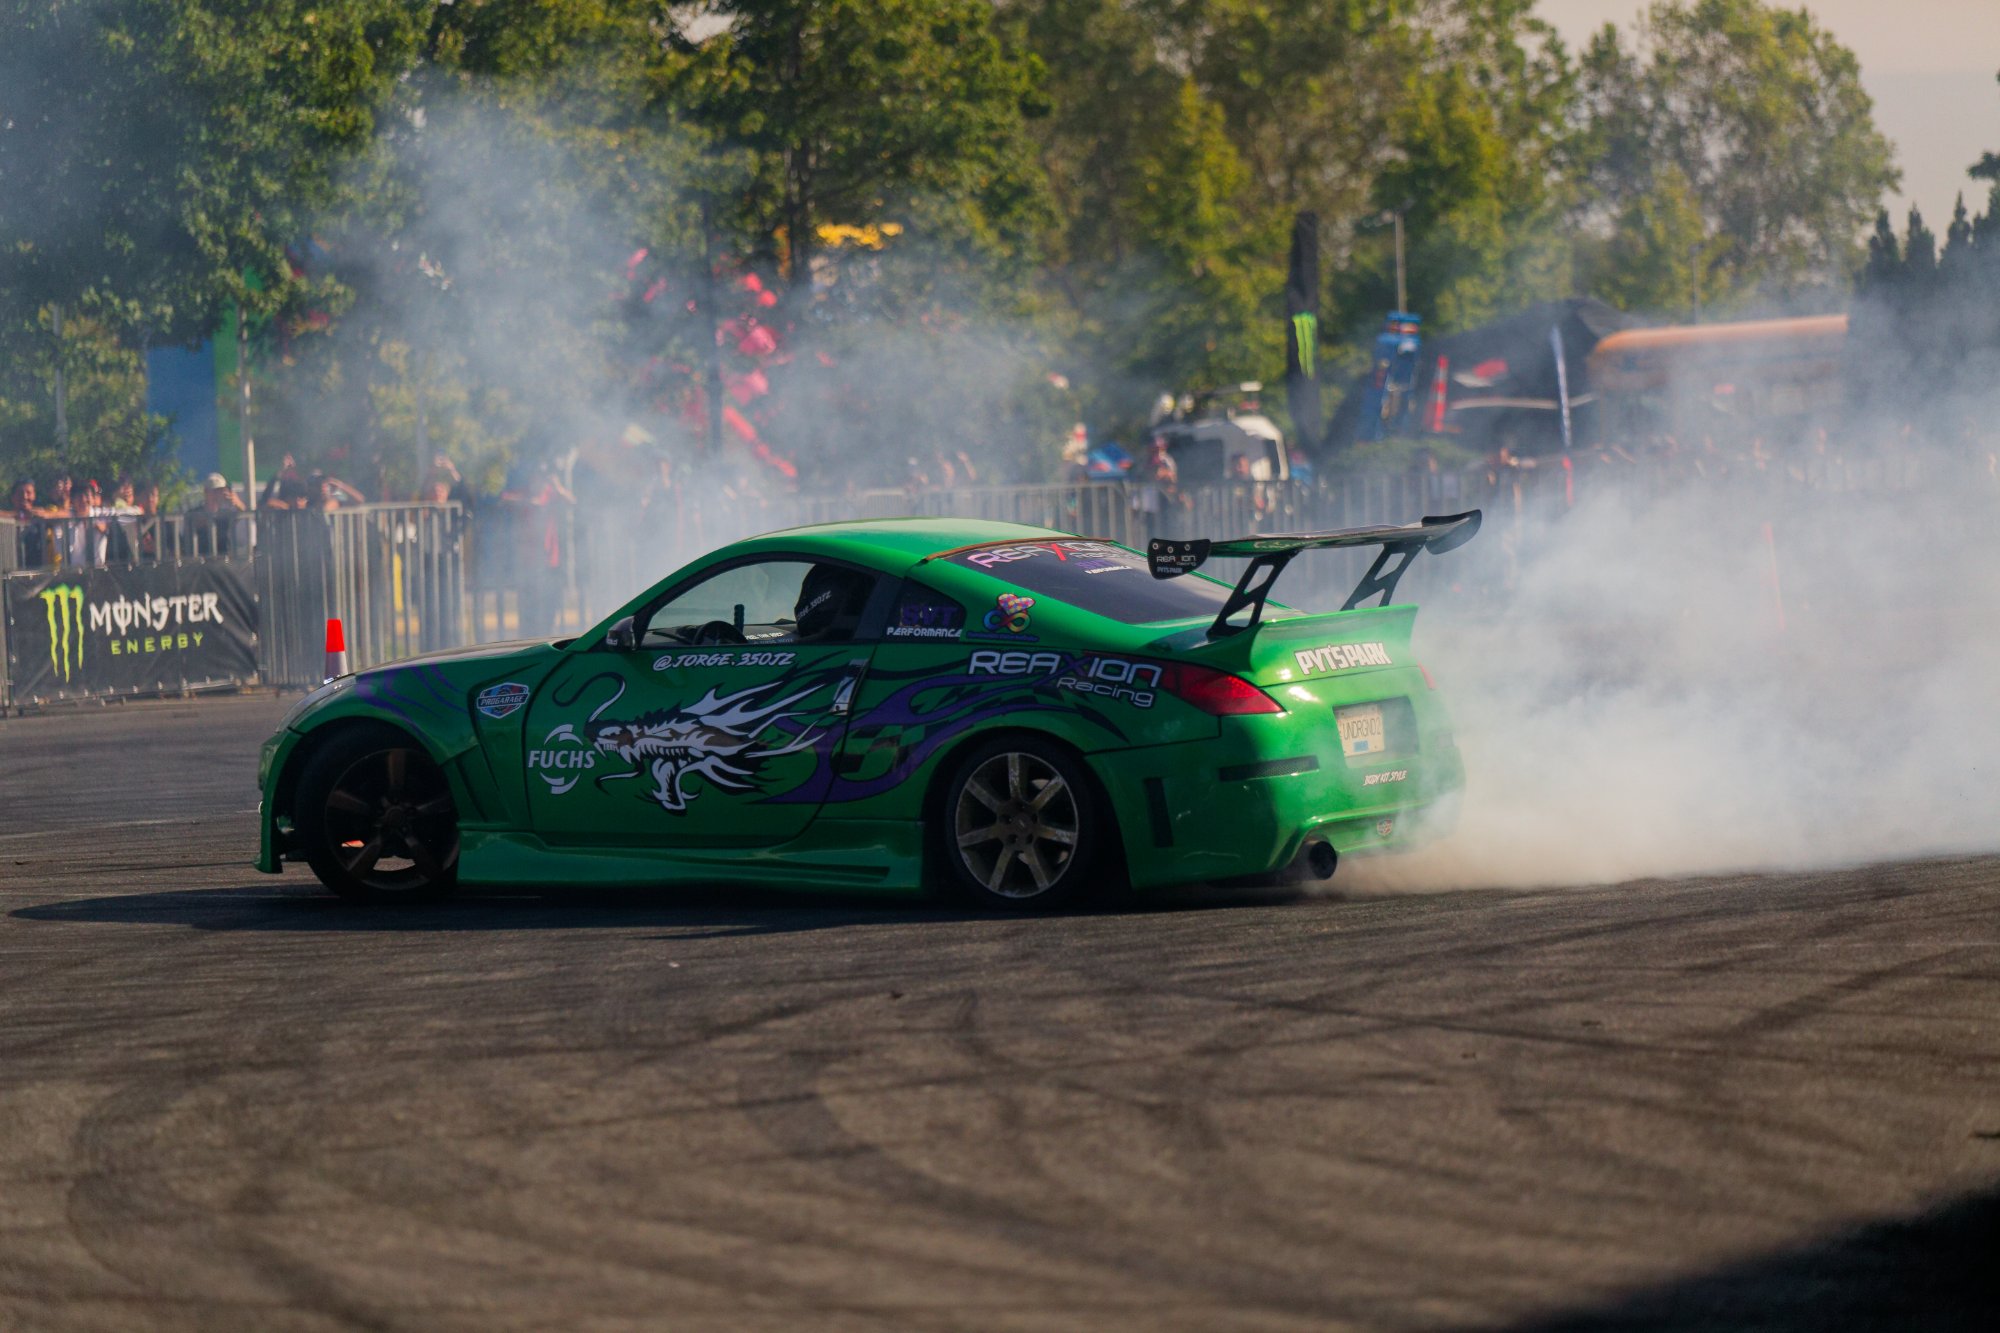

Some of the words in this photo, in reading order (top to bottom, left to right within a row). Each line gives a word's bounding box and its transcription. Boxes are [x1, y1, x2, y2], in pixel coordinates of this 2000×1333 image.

[89, 592, 224, 636] MONSTER
[110, 632, 203, 655] ENERGY
[886, 627, 963, 637] PERFORMANCE
[968, 651, 1163, 688] REAXION
[480, 695, 523, 706] PROGARAGE
[1057, 677, 1154, 707] Racing
[528, 750, 596, 769] FUCHS
